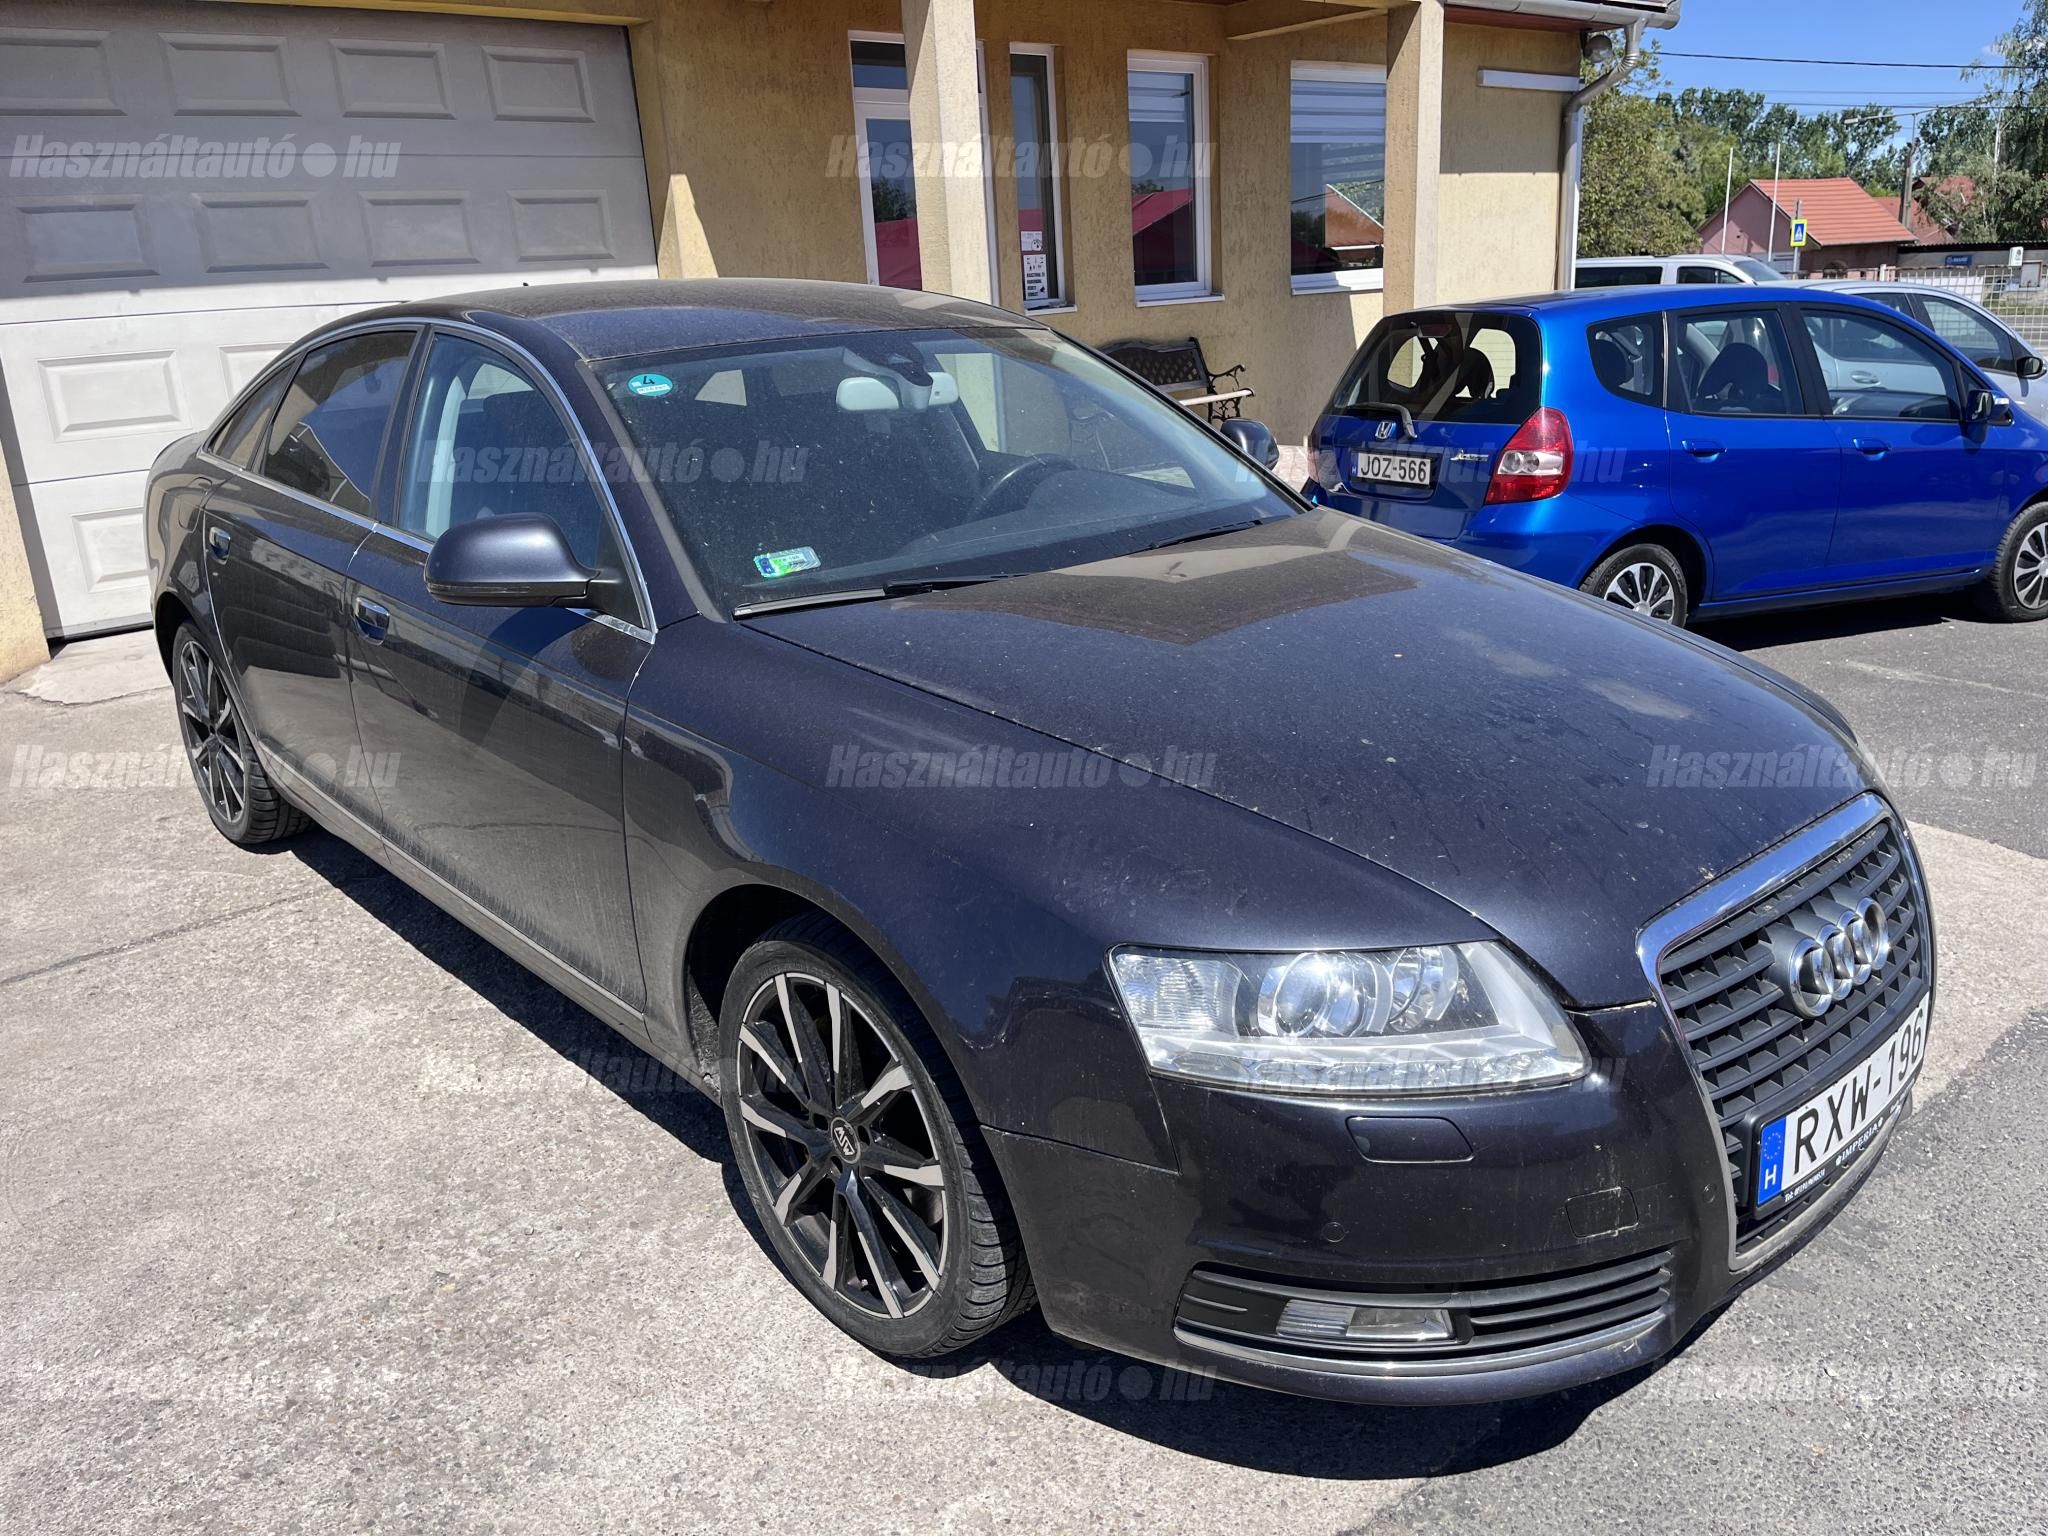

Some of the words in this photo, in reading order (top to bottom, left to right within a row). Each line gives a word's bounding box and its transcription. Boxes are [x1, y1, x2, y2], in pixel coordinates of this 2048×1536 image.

[1361, 455, 1427, 482] JOZ-566
[1764, 1164, 1777, 1190] H
[1793, 1007, 1924, 1175] RXW-196
